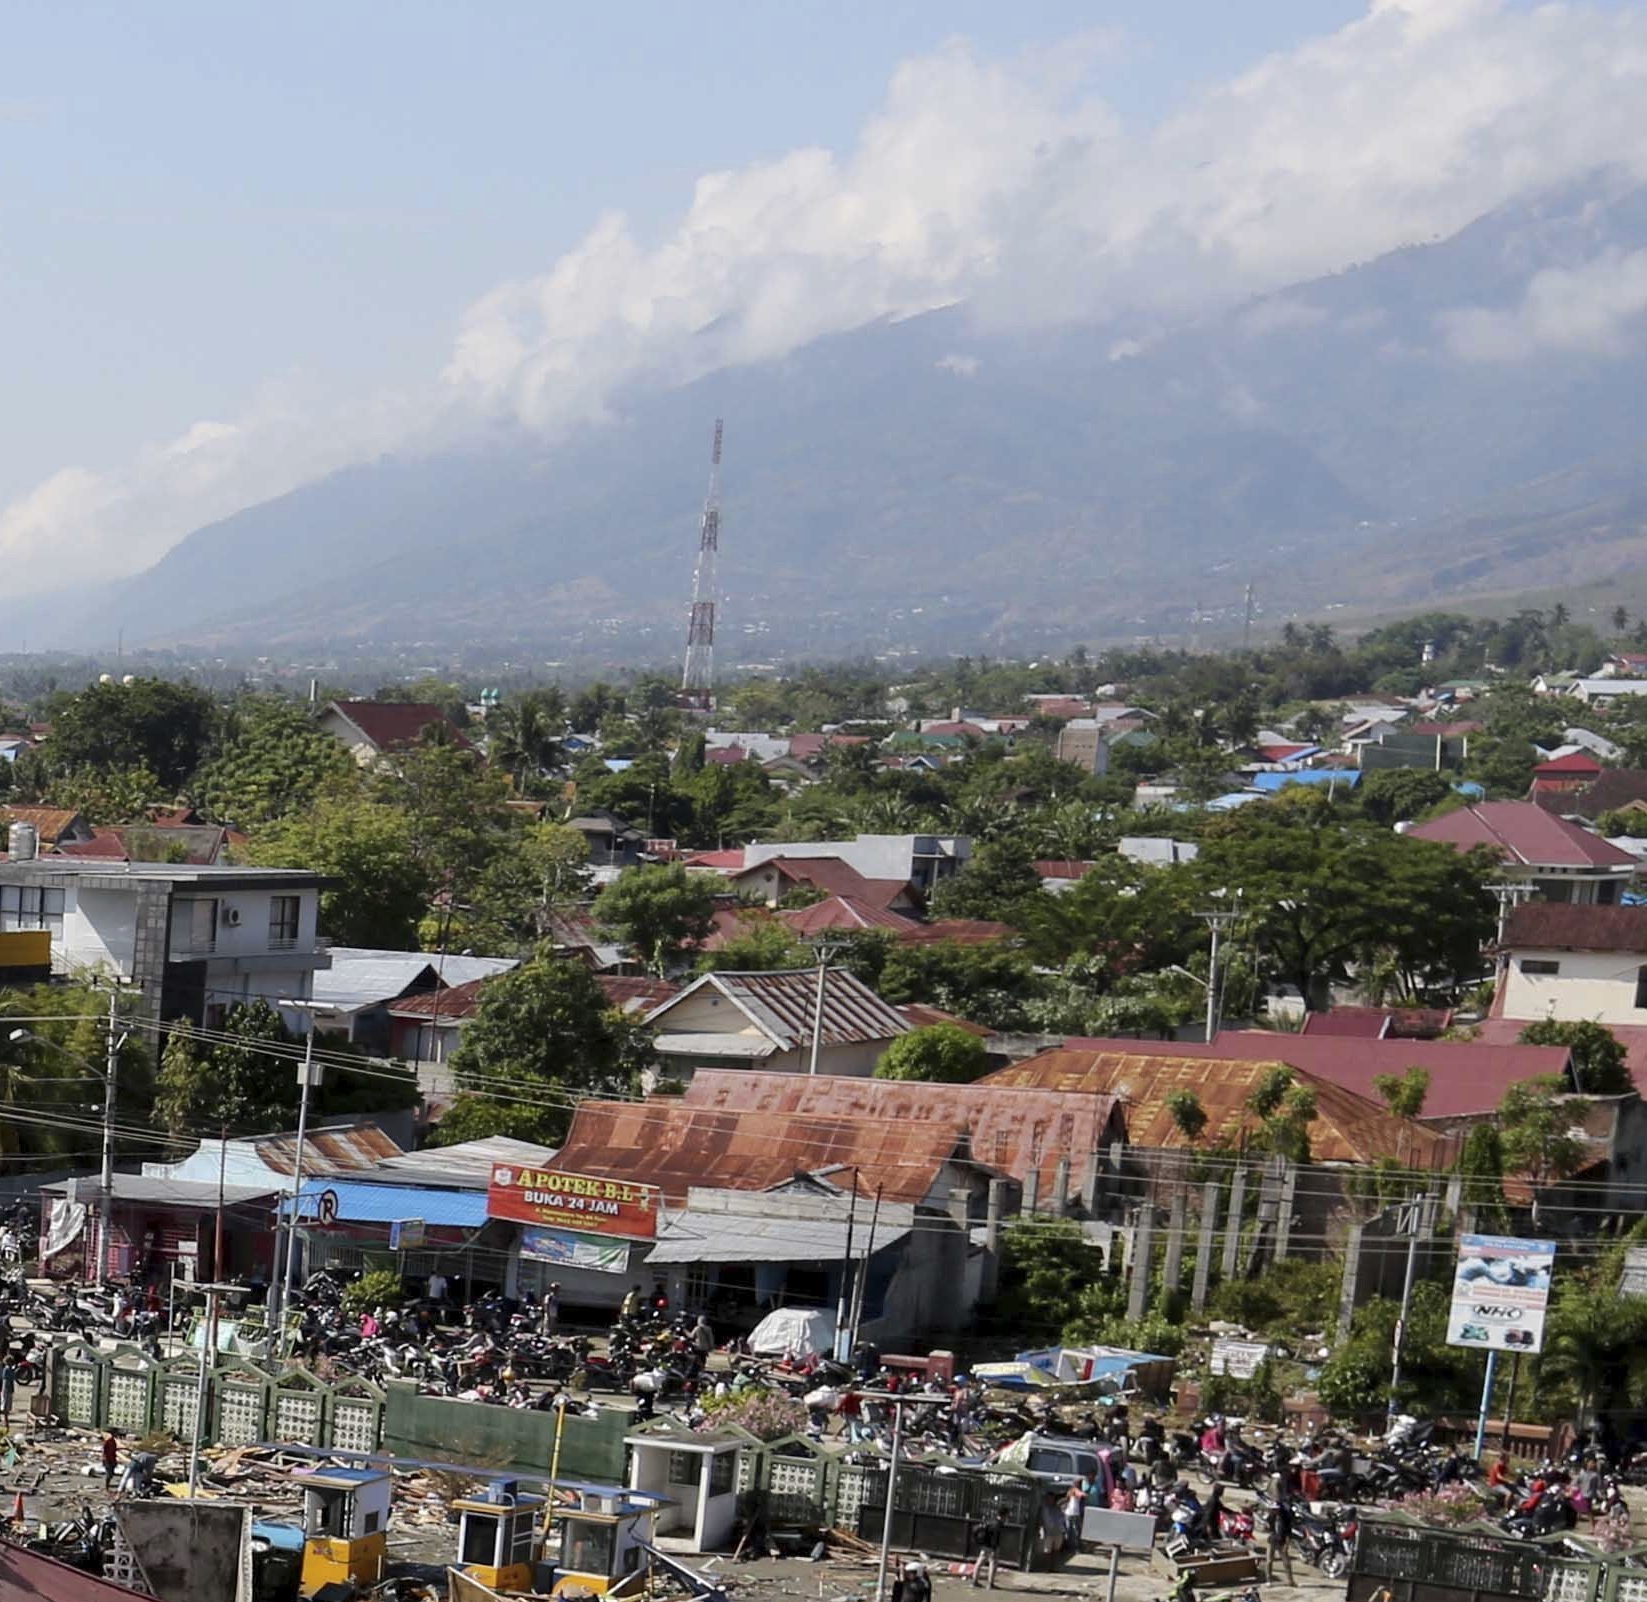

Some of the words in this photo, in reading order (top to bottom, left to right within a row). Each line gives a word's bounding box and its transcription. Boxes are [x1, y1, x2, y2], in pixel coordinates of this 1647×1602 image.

[516, 1169, 600, 1197] APOTEK
[524, 1190, 564, 1208] BUKA
[566, 1198, 585, 1210] 24
[588, 1200, 619, 1216] JAM
